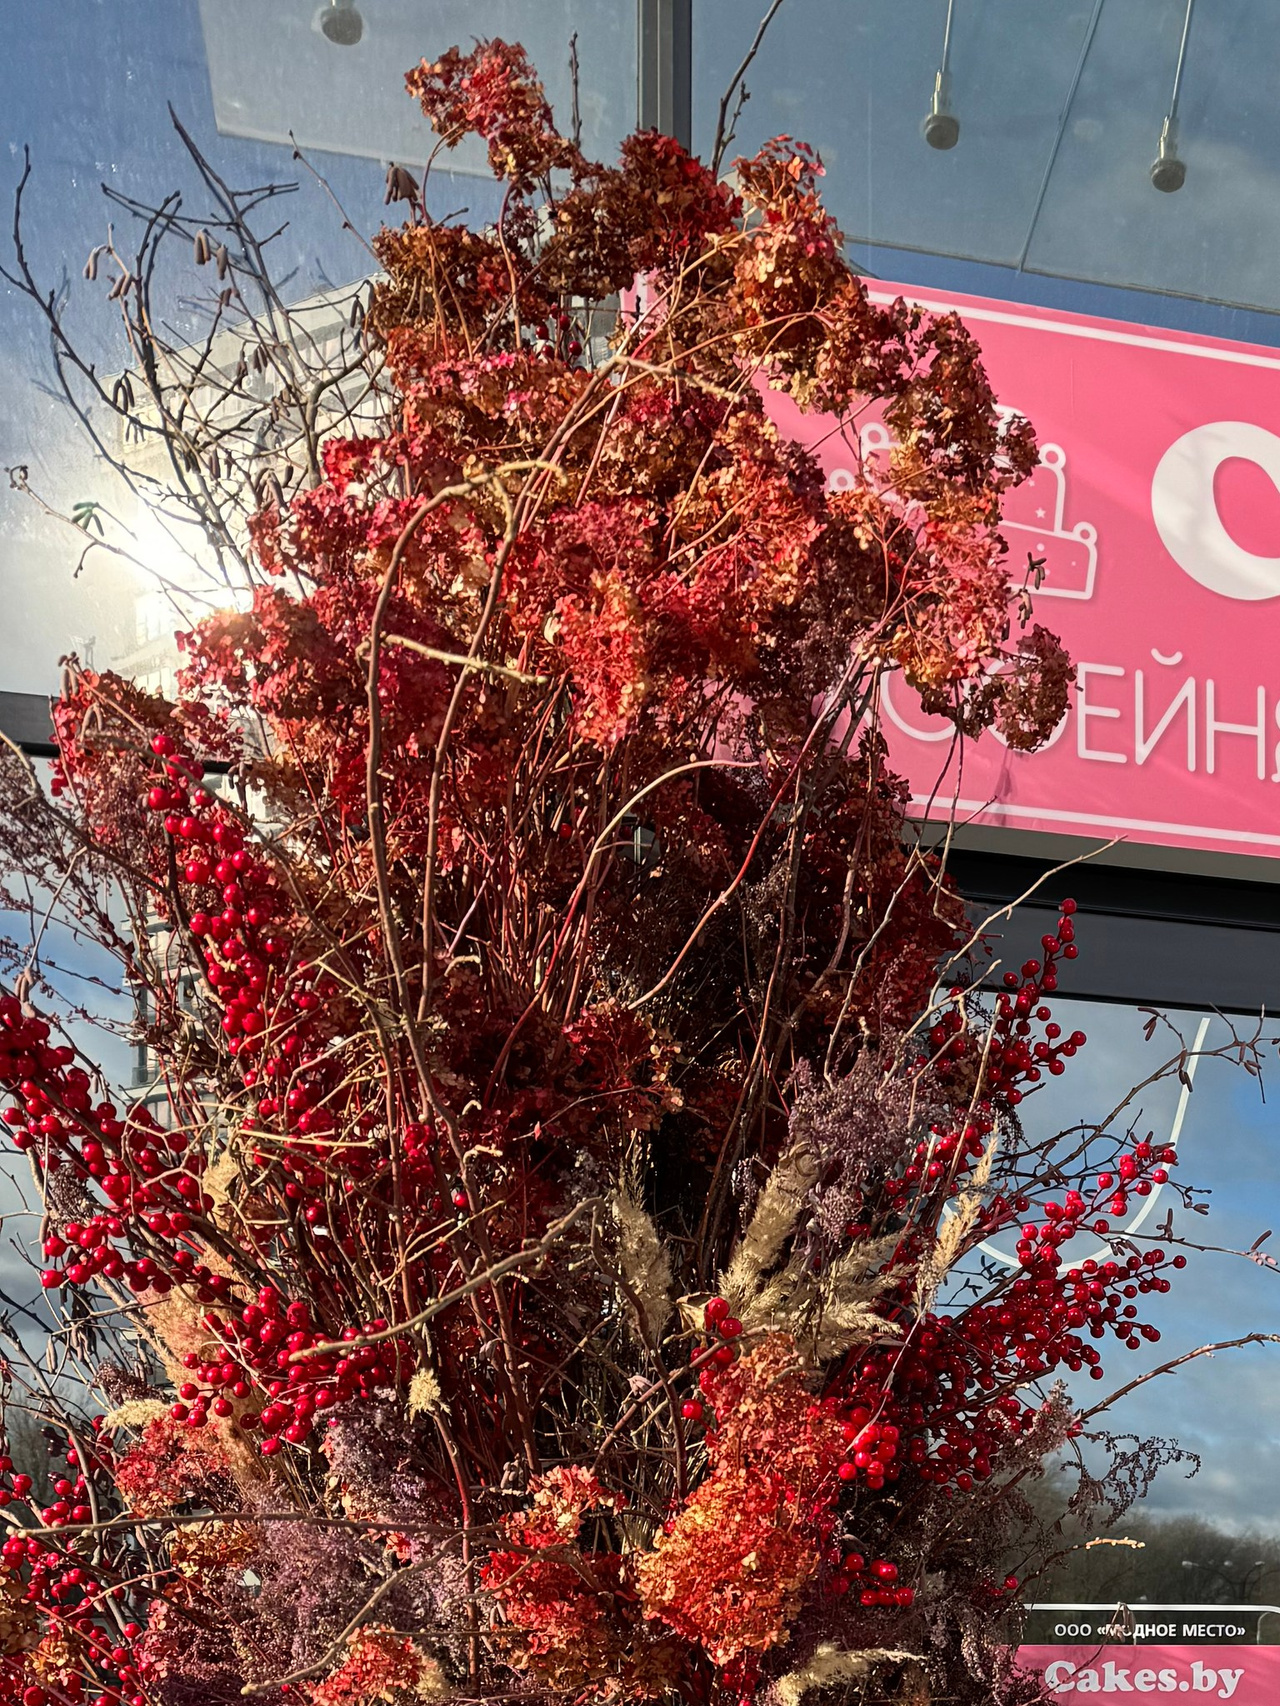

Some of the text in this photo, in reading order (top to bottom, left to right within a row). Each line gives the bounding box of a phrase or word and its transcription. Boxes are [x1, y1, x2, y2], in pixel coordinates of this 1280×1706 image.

[1054, 1623, 1092, 1637] ООО
[1183, 1622, 1246, 1637] МЕСТО»
[1044, 1660, 1245, 1698] Cakes.by
